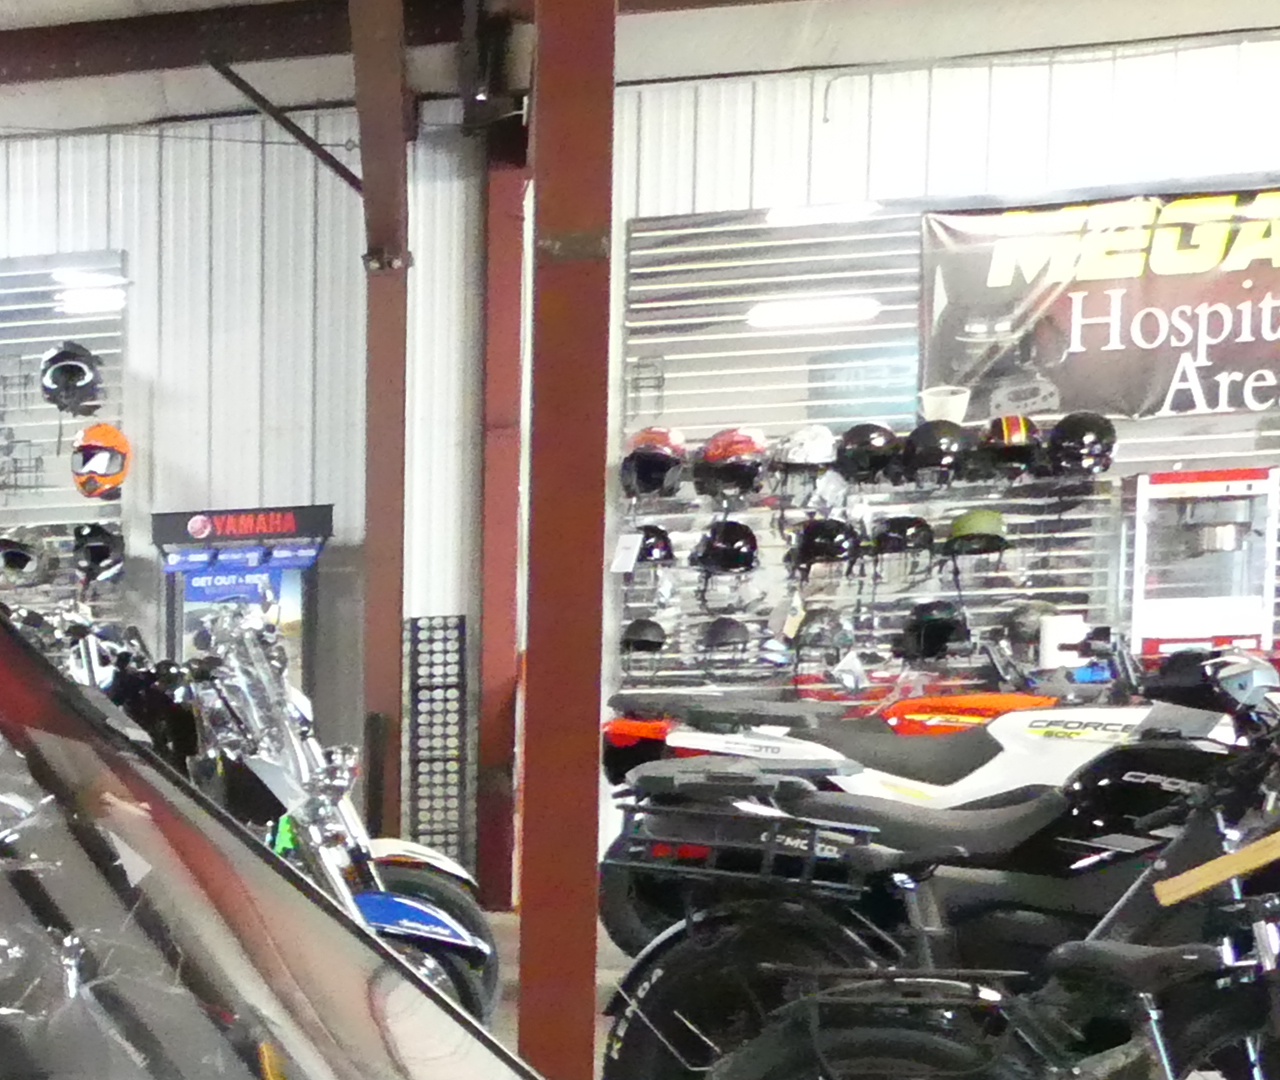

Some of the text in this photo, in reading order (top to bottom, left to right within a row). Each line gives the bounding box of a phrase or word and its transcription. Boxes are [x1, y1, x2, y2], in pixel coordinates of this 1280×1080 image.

[1155, 352, 1280, 416] Are
[213, 511, 297, 536] YAMAHA
[191, 575, 213, 587] GET
[214, 574, 237, 586] OUT
[1028, 719, 1137, 733] CFORCE
